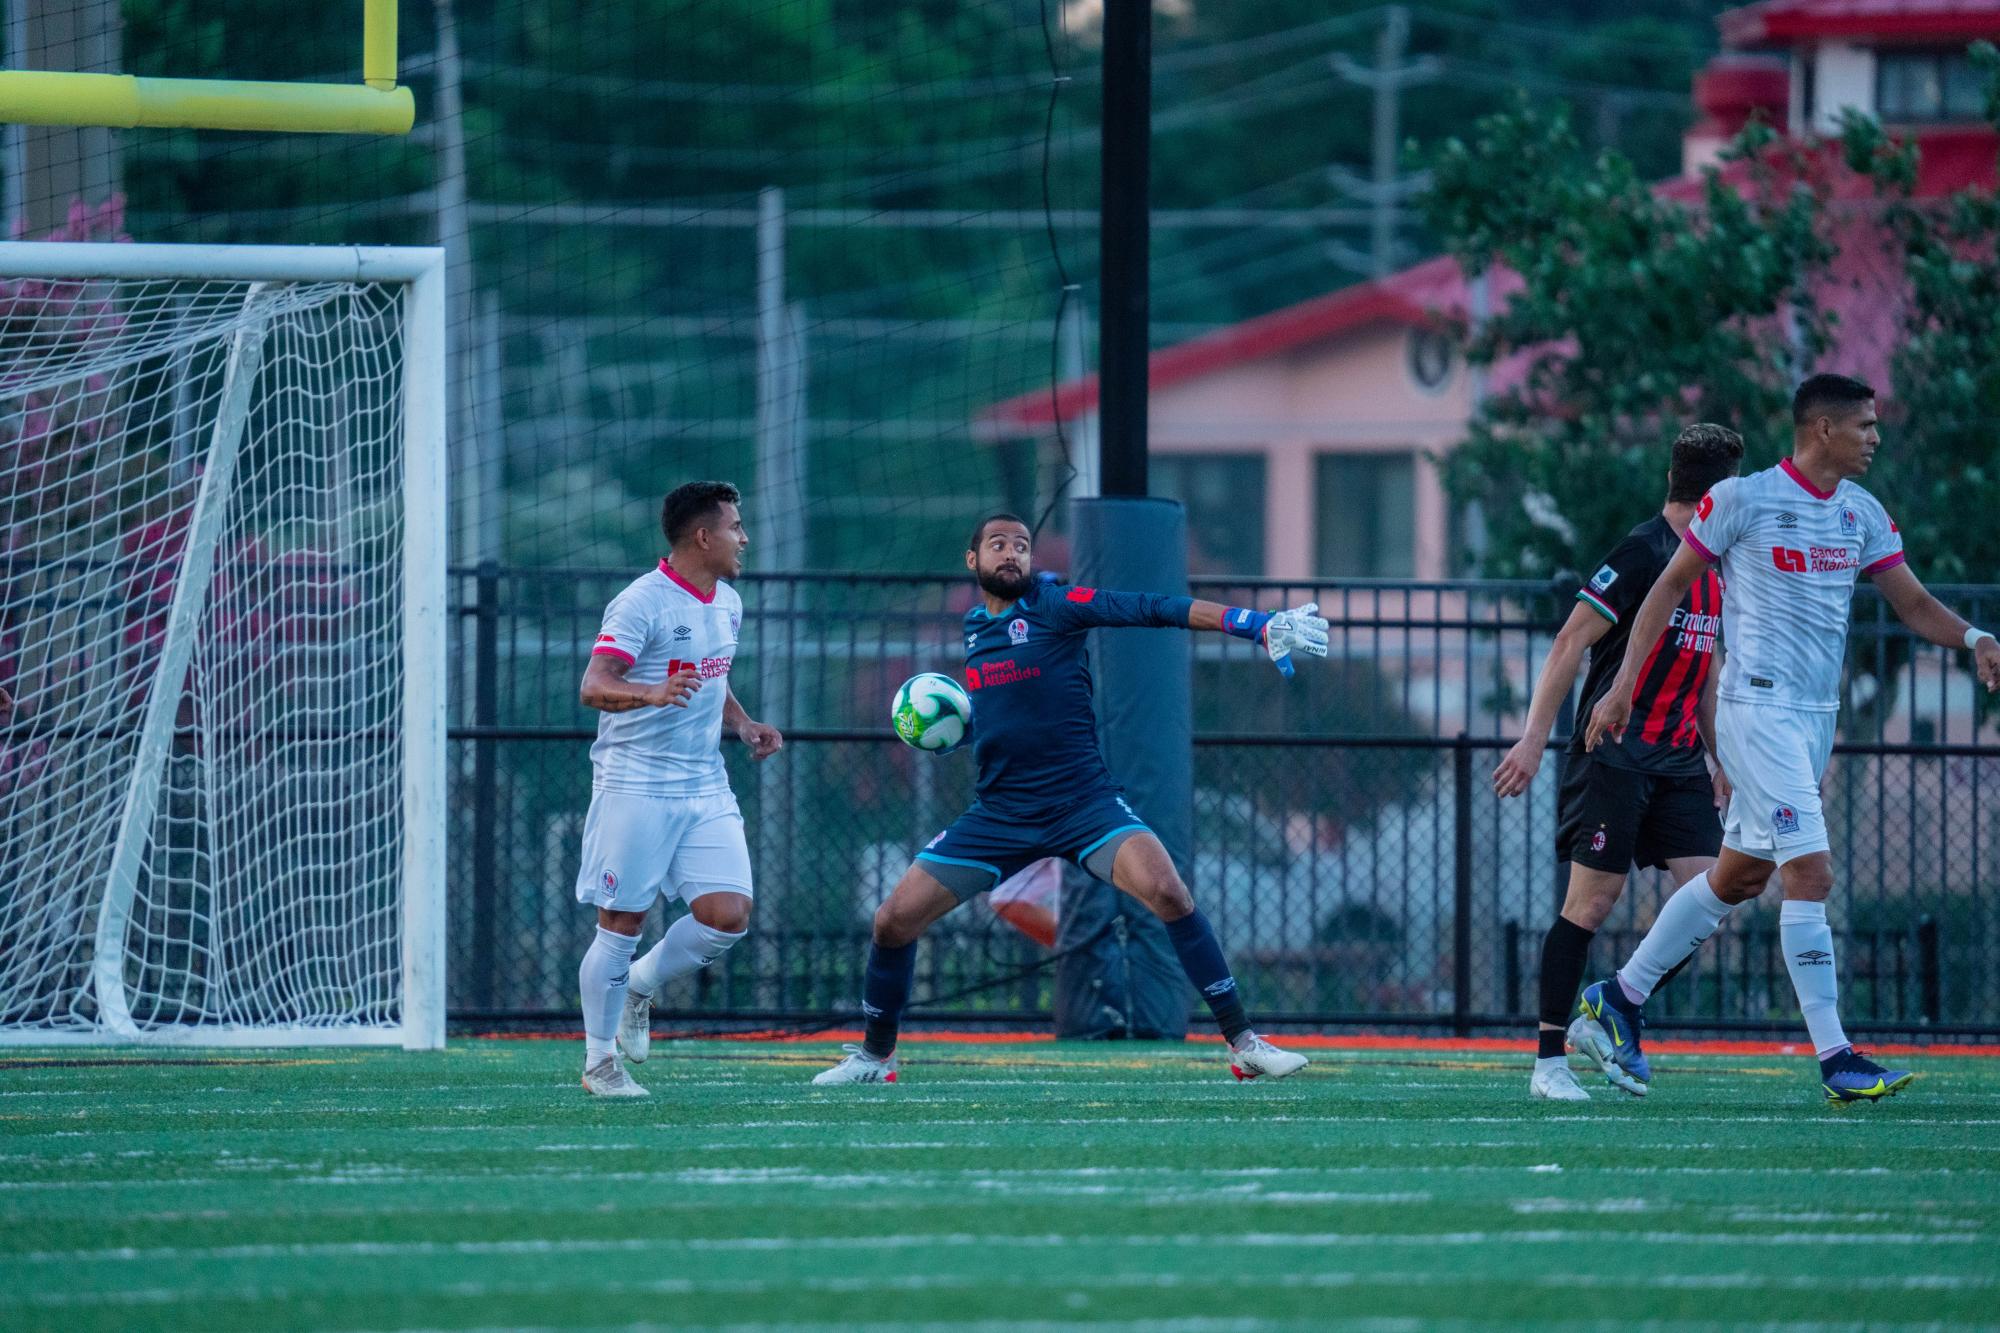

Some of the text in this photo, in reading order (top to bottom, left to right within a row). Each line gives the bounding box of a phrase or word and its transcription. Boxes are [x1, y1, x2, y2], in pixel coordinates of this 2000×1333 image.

[1810, 547, 1846, 558] Banco
[982, 659, 1015, 674] Banco
[1798, 959, 1832, 967] umbro
